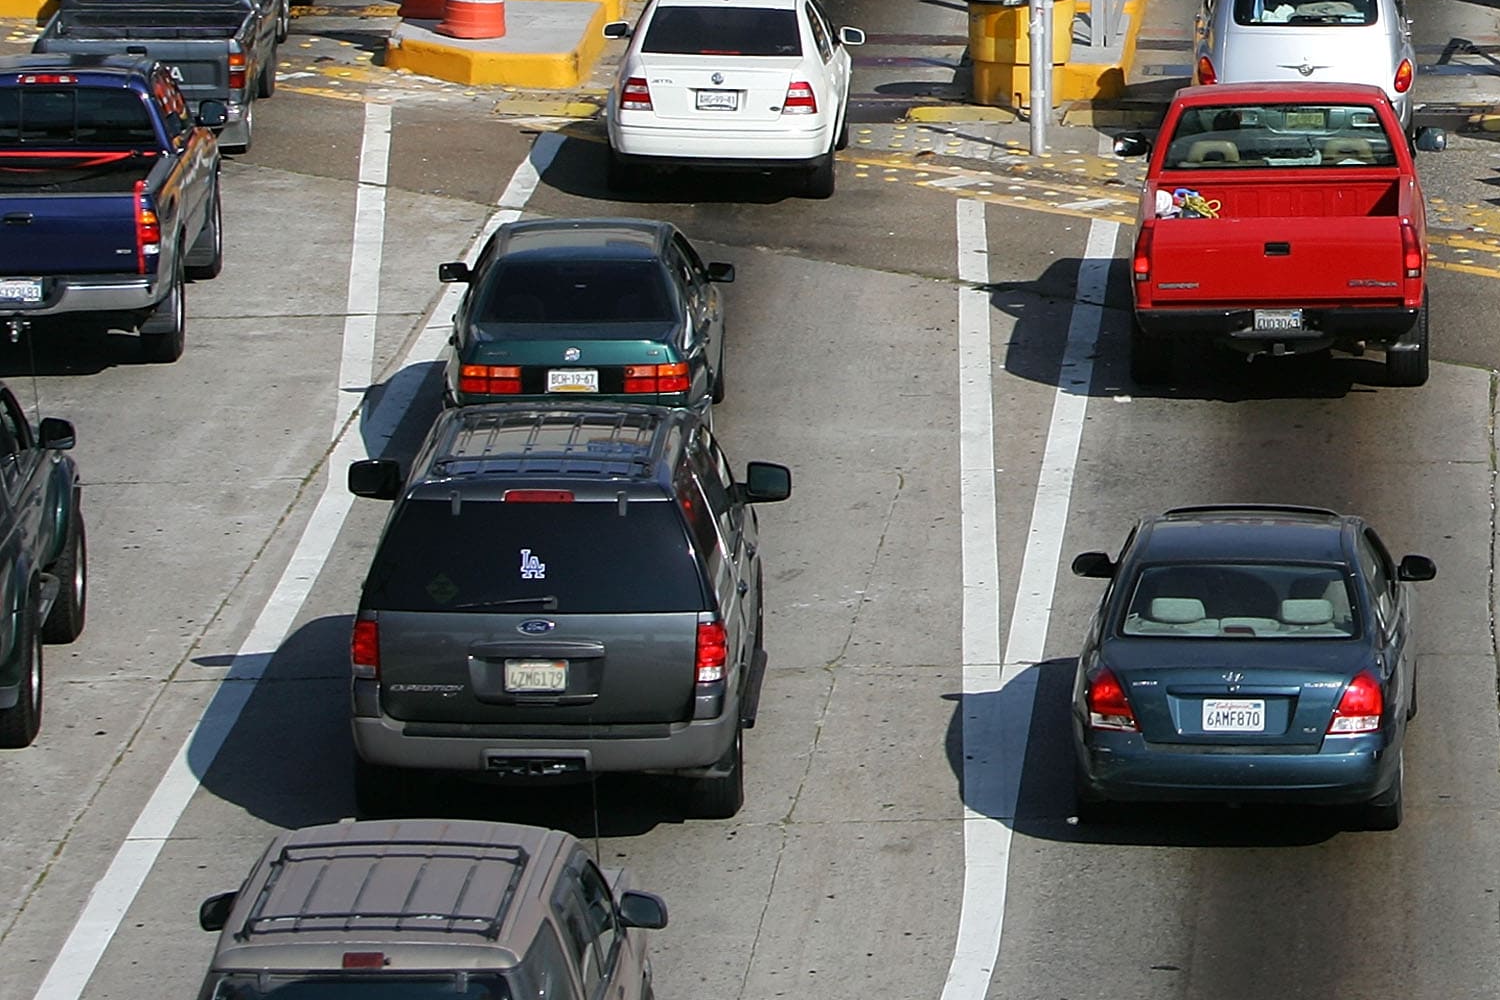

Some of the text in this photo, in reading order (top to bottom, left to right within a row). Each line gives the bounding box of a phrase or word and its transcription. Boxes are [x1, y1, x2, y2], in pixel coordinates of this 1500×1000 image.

[551, 373, 595, 385] BCH-19-67
[520, 548, 546, 579] LA
[510, 671, 564, 688] 4ZMG179
[389, 684, 464, 692] EXPEDITION
[1206, 711, 1260, 727] 6AMF870
